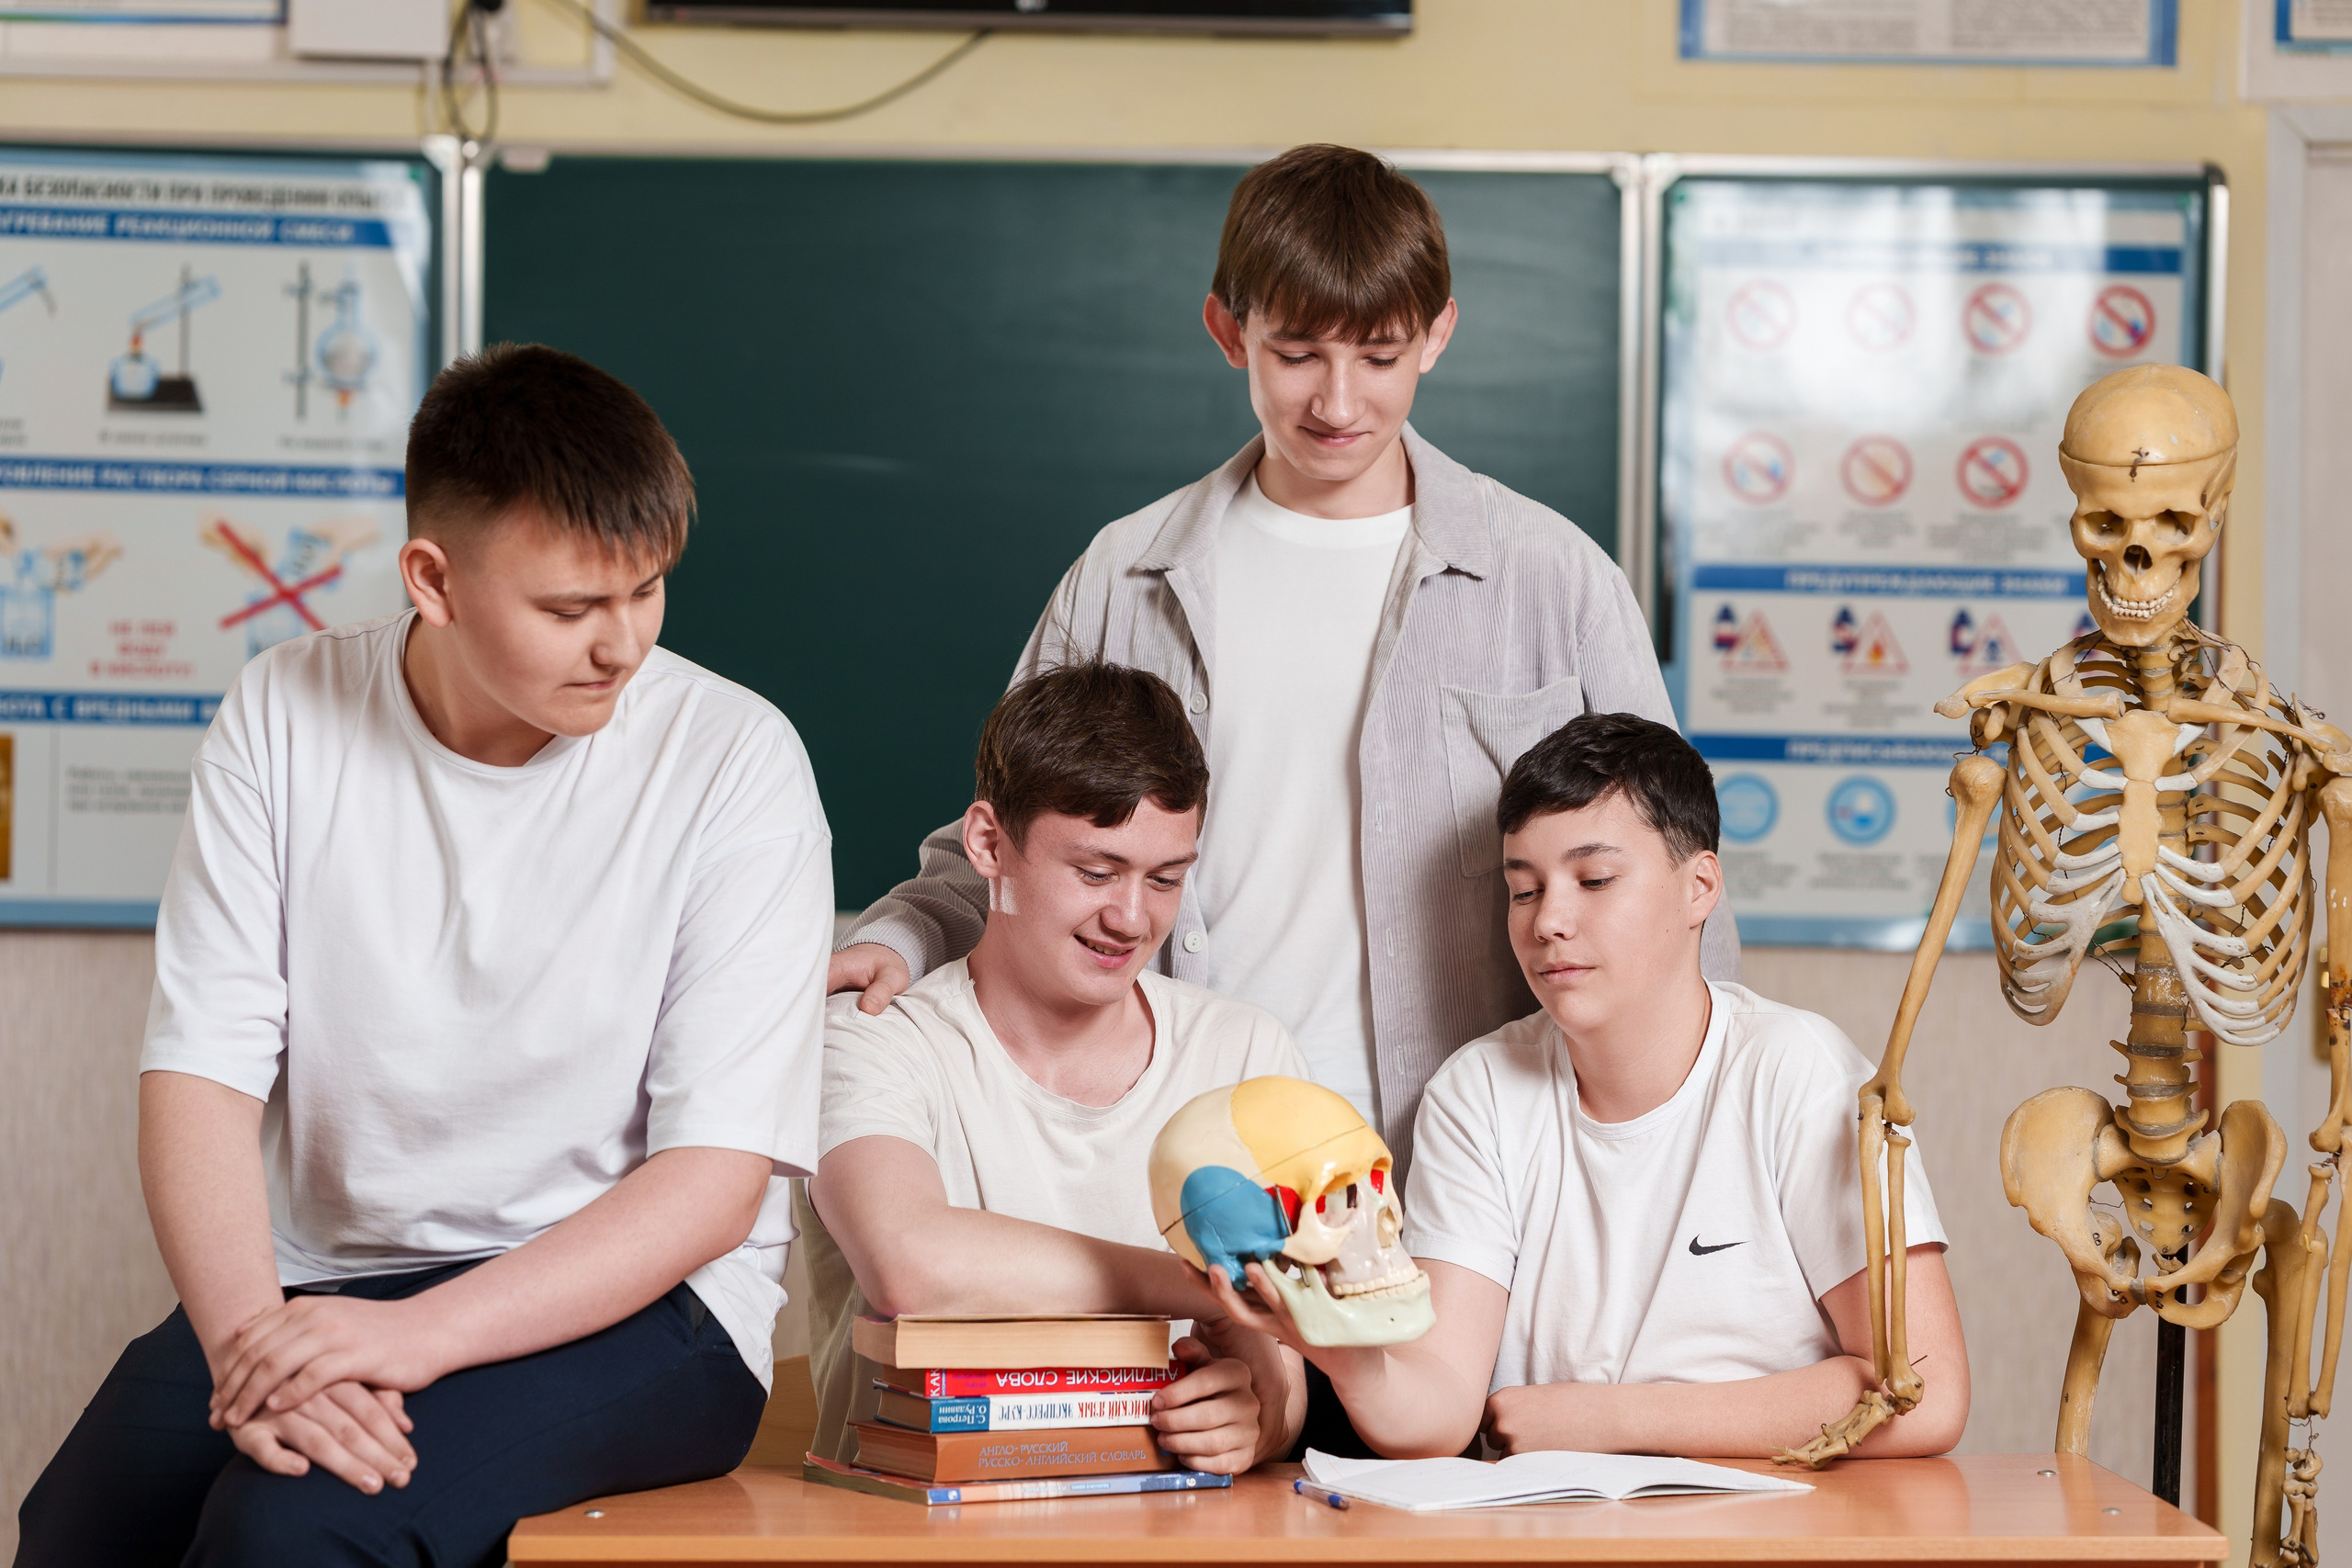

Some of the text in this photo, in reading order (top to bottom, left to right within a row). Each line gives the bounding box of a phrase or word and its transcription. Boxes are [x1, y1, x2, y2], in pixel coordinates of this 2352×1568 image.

[996, 1368, 1179, 1388] АНГЛИЙСКИЕ СЛОВА
[998, 1399, 1153, 1422] ИЙСКИЙ ЯЗЫК ЭКСПРЕСС-КУРС
[1099, 1449, 1147, 1462] СЛОВАРЬ
